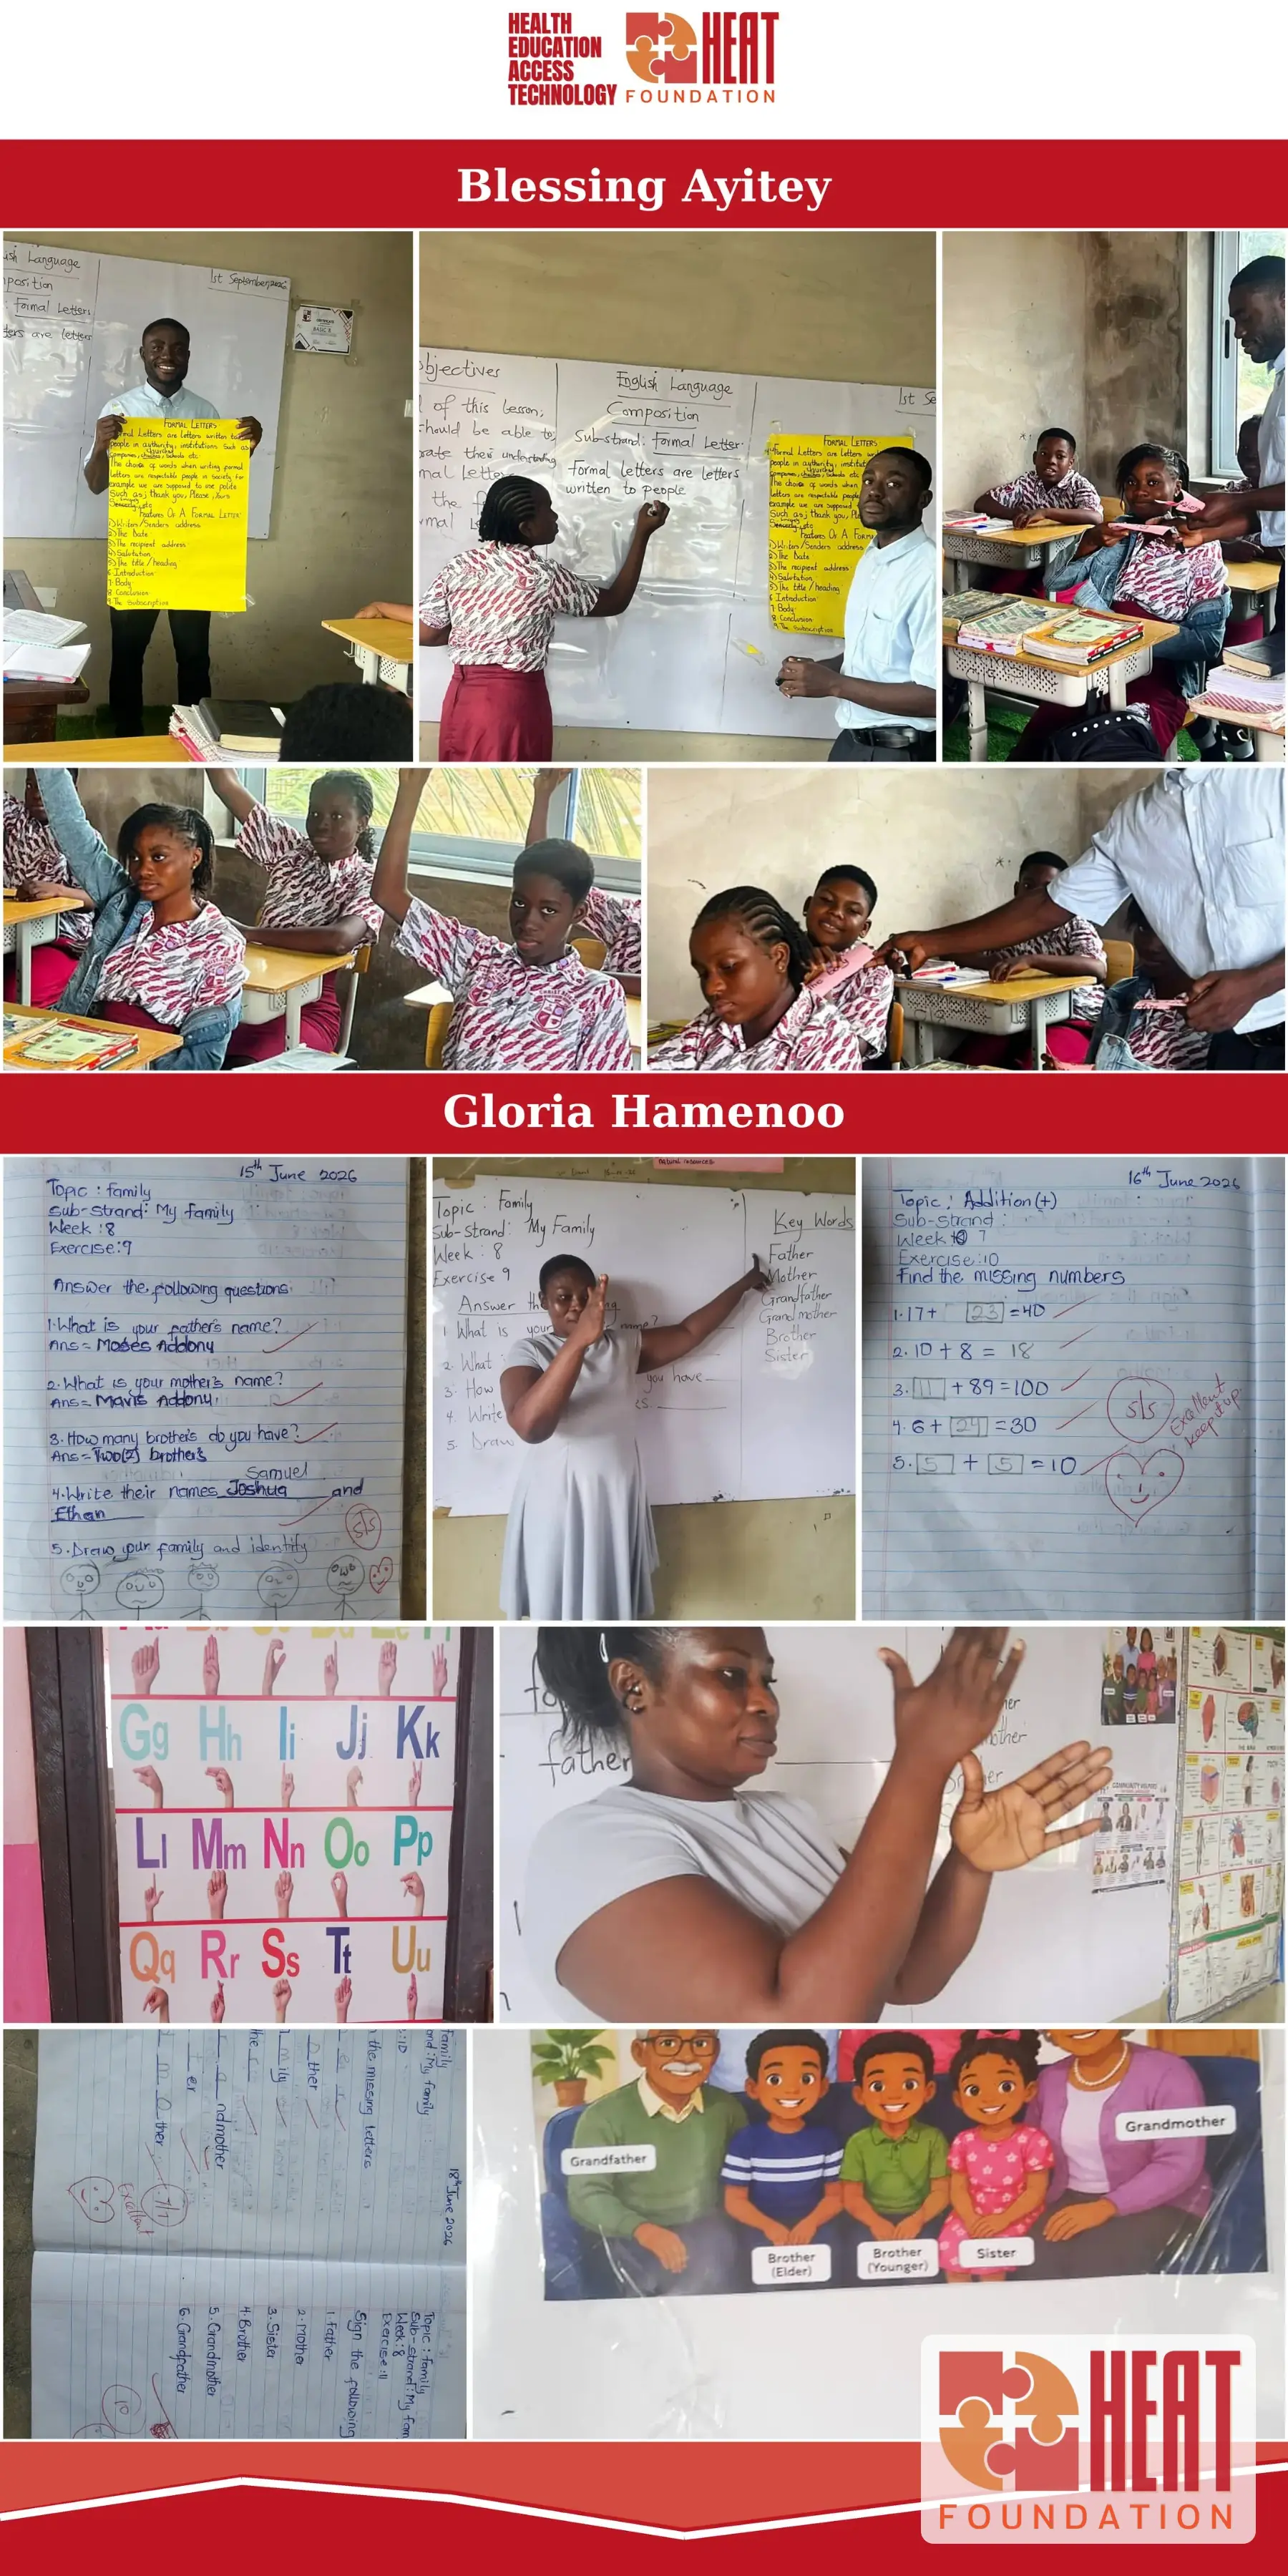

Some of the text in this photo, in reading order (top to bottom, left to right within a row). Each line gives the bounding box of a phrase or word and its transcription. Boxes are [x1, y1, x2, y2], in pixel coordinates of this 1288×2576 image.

[29, 250, 80, 273] Language
[14, 297, 91, 316] Formal Letters
[62, 328, 92, 341] letters
[616, 371, 733, 401] English Language
[434, 394, 489, 421] of this
[607, 401, 699, 426] Composition
[164, 418, 217, 429] FORMAL LETTERS
[472, 420, 535, 439] be able
[138, 429, 162, 438] Letters
[652, 431, 694, 449] Formal
[824, 435, 878, 447] FORMAL LETTERS
[110, 441, 130, 452] people
[798, 446, 822, 456] Letters
[568, 460, 740, 481] Formal letters are letters
[566, 482, 610, 494] written
[623, 482, 636, 494] to
[431, 490, 462, 509] the
[140, 508, 164, 518] Features
[133, 529, 148, 537] Date
[130, 541, 156, 550] recipient
[114, 568, 155, 577] Introduction
[269, 1163, 307, 1183] June
[320, 1169, 357, 1182] 2026
[1156, 1171, 1240, 1190] June 2026
[47, 1179, 88, 1207] Topic
[893, 1189, 941, 1214] Topic
[156, 1204, 234, 1225] My family
[499, 1190, 533, 1224] Family
[49, 1222, 92, 1236] Week
[528, 1214, 595, 1248] My Family
[774, 1206, 854, 1242] Key Words
[898, 1231, 946, 1246] Week
[769, 1244, 814, 1262] Father
[433, 1271, 494, 1287] Exercise
[768, 1269, 818, 1284] Mother
[897, 1268, 1125, 1292] Find missing numbers
[54, 1277, 218, 1304] Answer following
[762, 1284, 832, 1307] Grandfather
[459, 1298, 516, 1312] Answer
[104, 1317, 119, 1333] is
[132, 1323, 158, 1343] your
[231, 1318, 281, 1335] name?
[457, 1321, 488, 1339] What
[766, 1325, 816, 1345] Brother
[765, 1347, 809, 1362] Sister
[915, 1343, 1033, 1360] 10 8 18
[235, 1372, 284, 1387] name?
[673, 1367, 703, 1382] have
[467, 1381, 493, 1395] How
[95, 1392, 148, 1409] Mavis
[469, 1408, 502, 1422] Write
[102, 1433, 140, 1452] many
[209, 1428, 225, 1444] do
[472, 1436, 514, 1449] Draw
[246, 1466, 308, 1480] Samuel
[121, 1481, 364, 1498] their names Joshua and
[54, 1508, 105, 1521] Ethan
[157, 1533, 308, 1563] family and identify
[119, 1704, 440, 1761] Gg Hh Ii Jj Kk
[538, 1729, 632, 1788] father
[136, 1815, 433, 1870] Ll Mm Nn Oo Pp
[130, 1926, 430, 1984] Qq Rr Ss Tt Uu
[416, 2080, 435, 2115] family
[359, 2067, 375, 2168] missing letters
[1125, 2115, 1226, 2134] Grandmother
[570, 2152, 648, 2167] Grandfather
[445, 2186, 459, 2213] June
[443, 2218, 454, 2245] 2026
[767, 2252, 816, 2265] Brother
[873, 2246, 923, 2260] Brother
[976, 2246, 1016, 2260] Sister
[771, 2265, 813, 2279] (Elder)
[866, 2259, 929, 2274] (Younger)
[414, 2312, 435, 2394] Topic family
[339, 2310, 367, 2439] Sign the following
